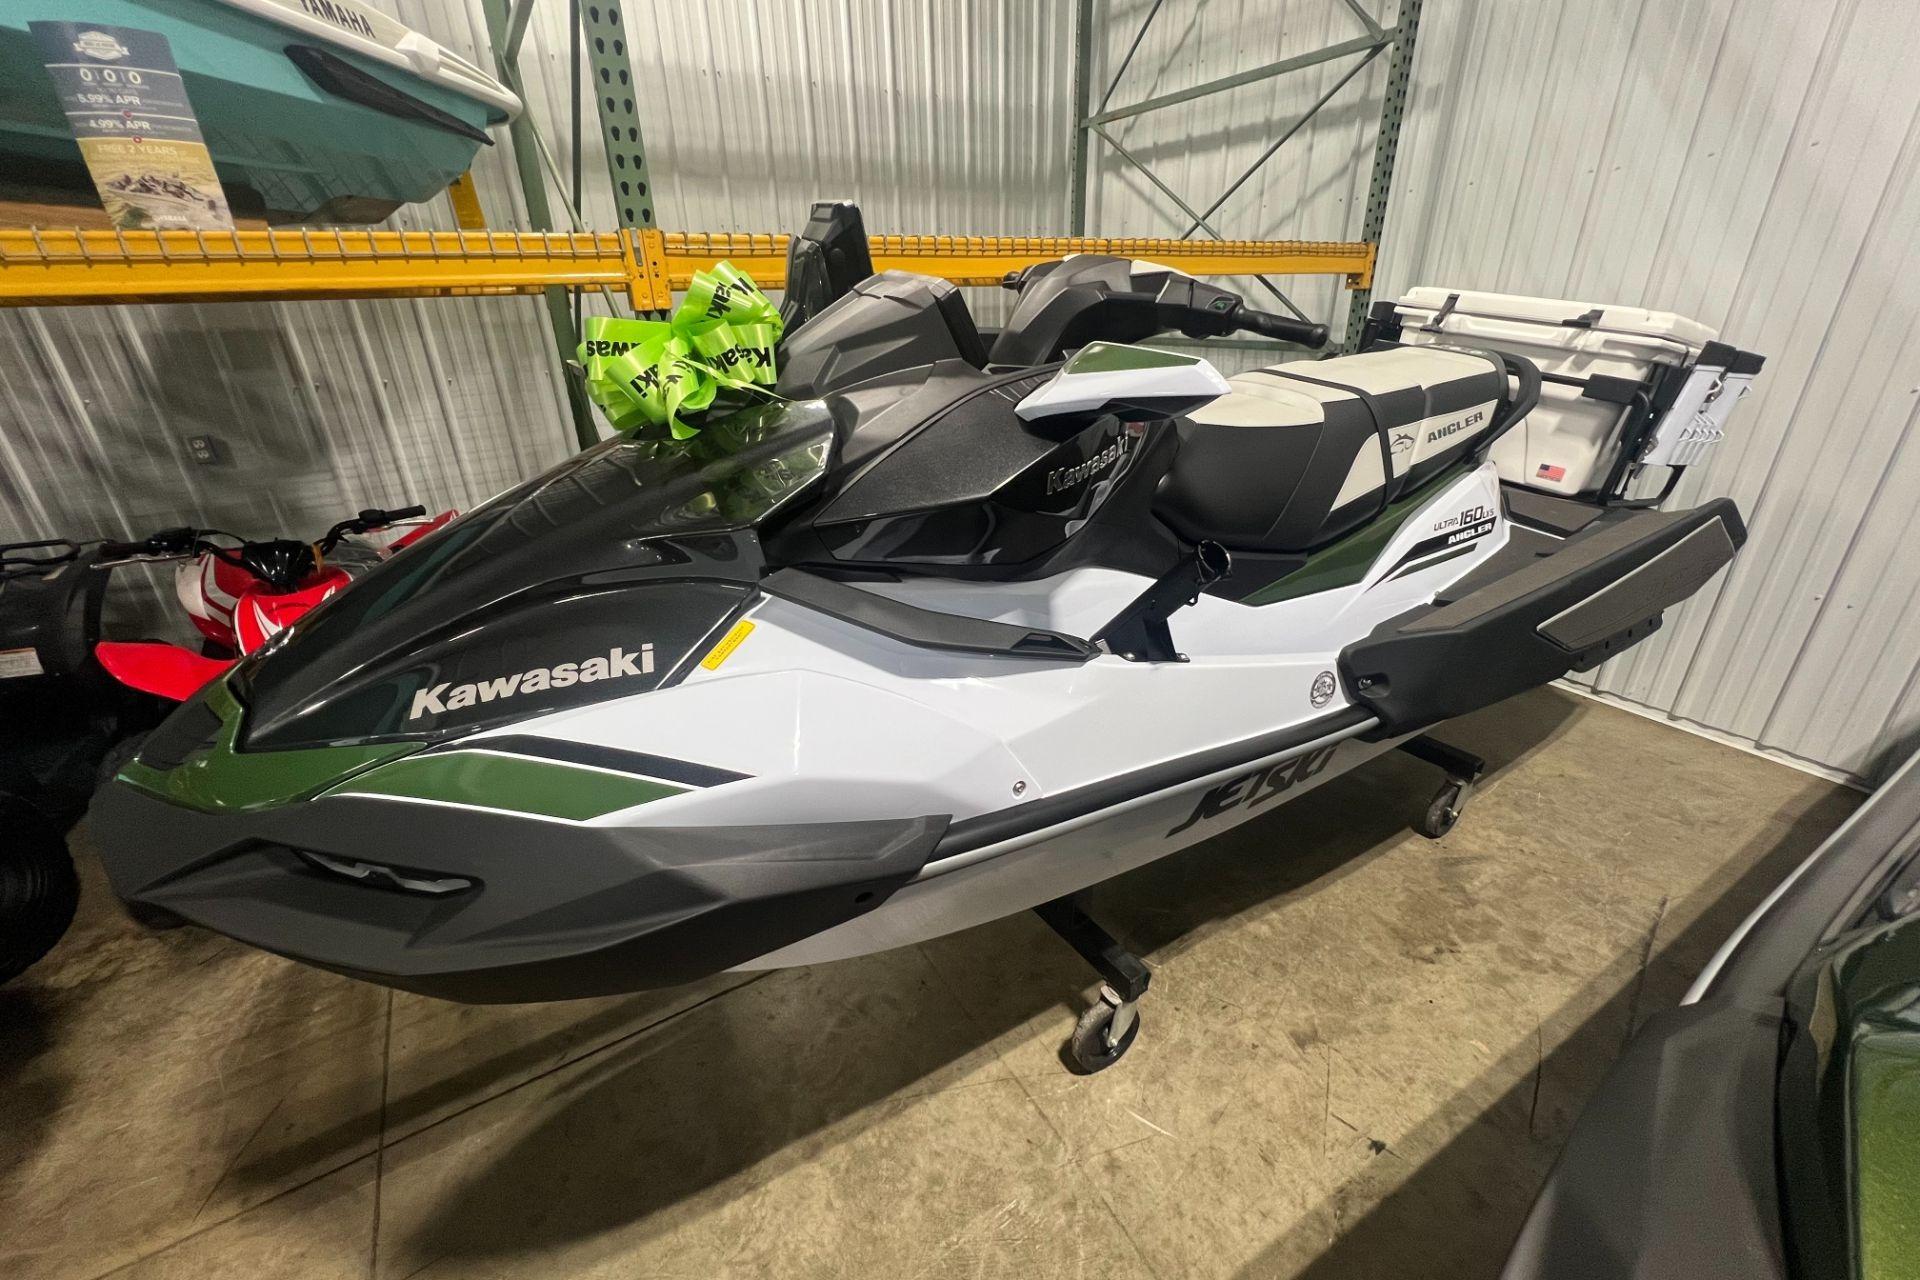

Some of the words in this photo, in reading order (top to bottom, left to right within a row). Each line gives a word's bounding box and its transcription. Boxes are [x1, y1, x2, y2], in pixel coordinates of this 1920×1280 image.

[115, 95, 141, 106] APR
[126, 120, 151, 130] APR
[139, 144, 177, 155] YEARS
[1426, 411, 1484, 443] ANGLER
[1046, 430, 1129, 495] Kawasaki
[1447, 522, 1492, 545] ANGLER
[408, 642, 656, 720] Kawasaki
